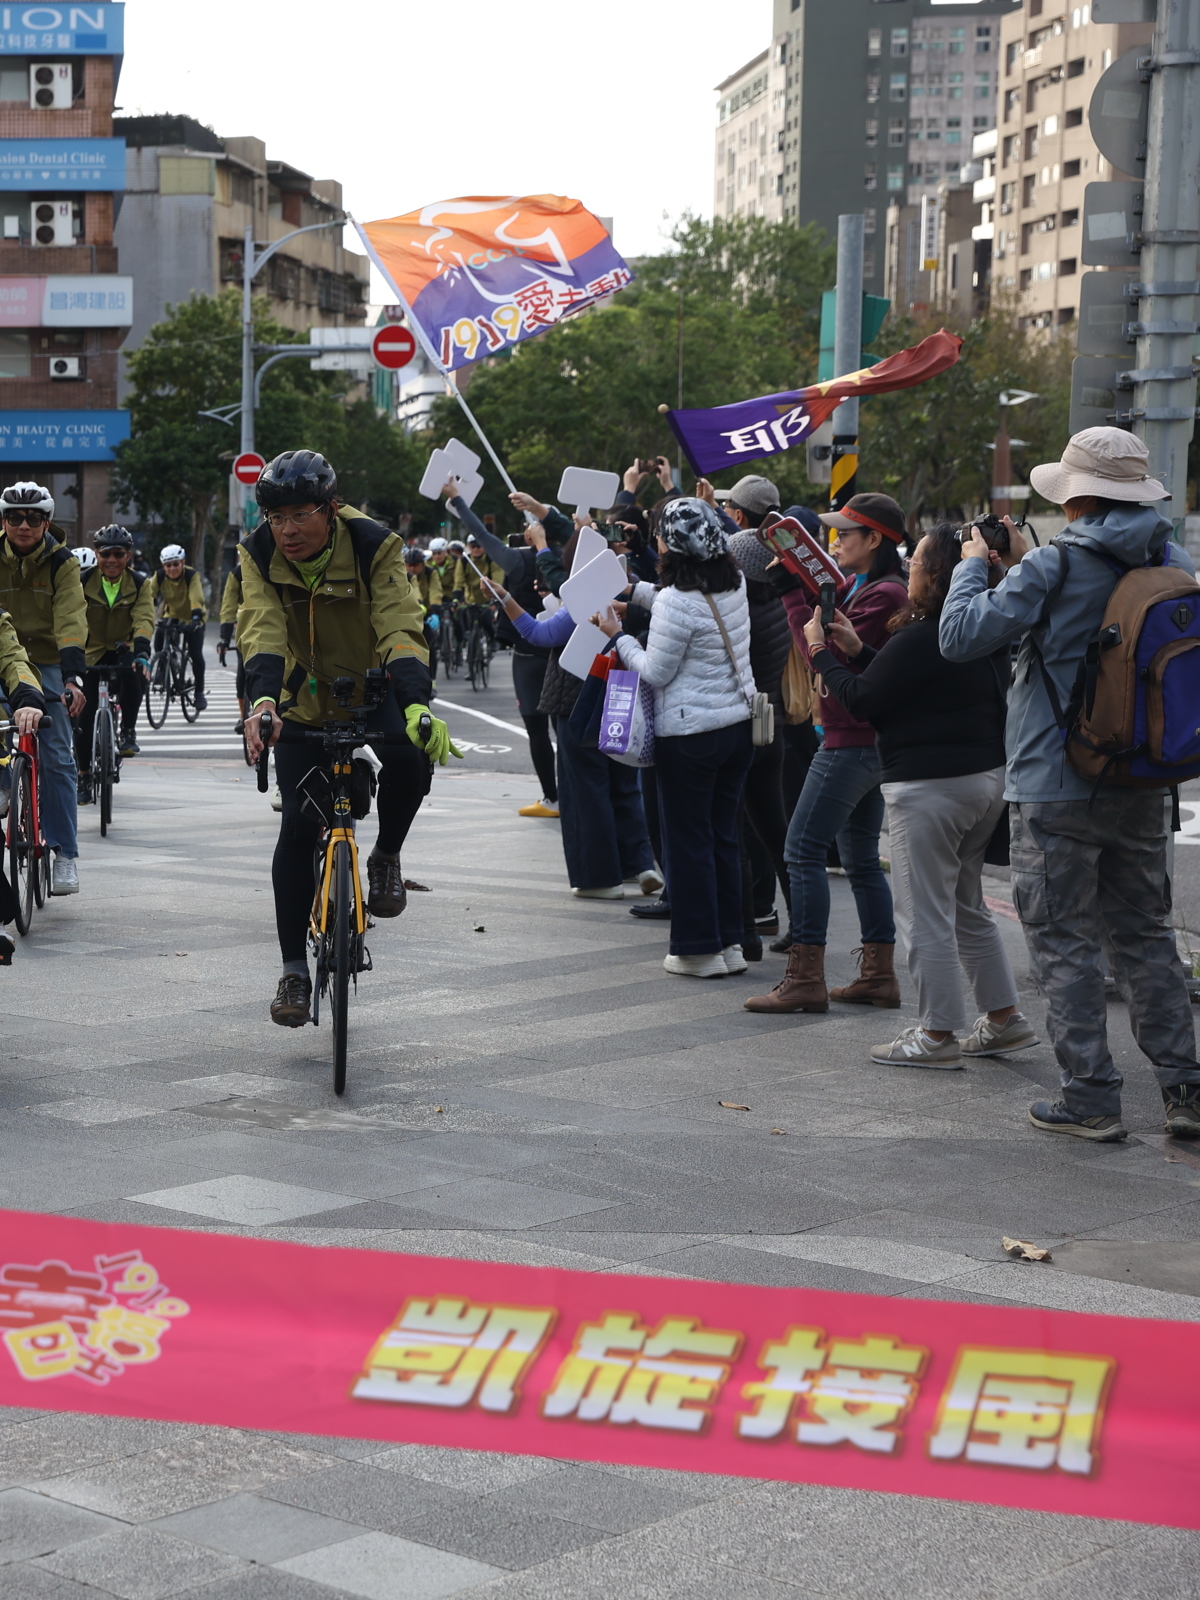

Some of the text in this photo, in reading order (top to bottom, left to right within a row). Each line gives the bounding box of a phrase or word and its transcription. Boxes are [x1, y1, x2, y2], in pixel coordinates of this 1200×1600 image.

[29, 151, 68, 164] Dental
[70, 151, 106, 164] Clinic
[16, 425, 61, 435] BEAUTY
[66, 425, 106, 435] CLINIC
[352, 1294, 1118, 1476] 凱旋接風
